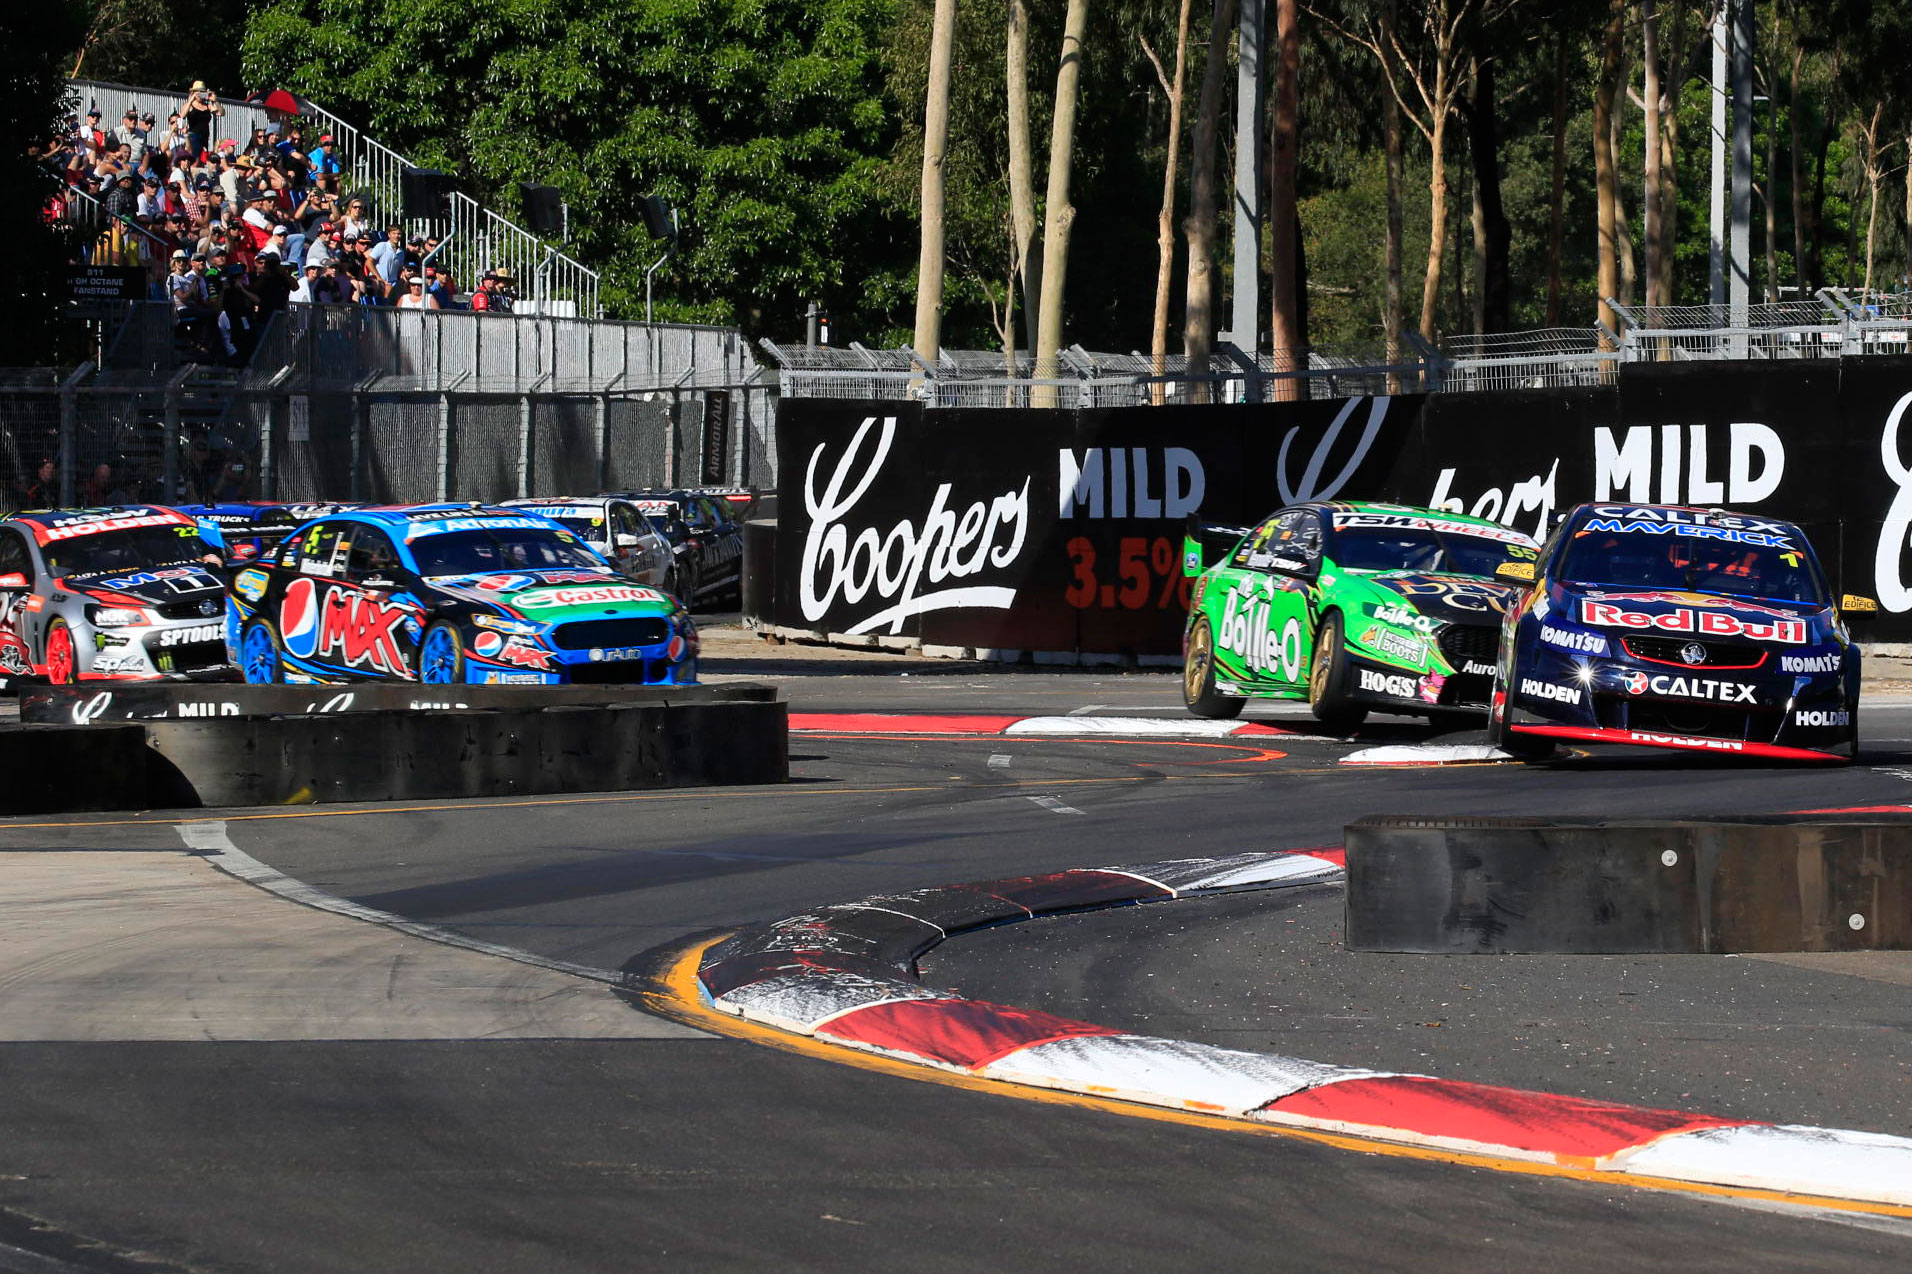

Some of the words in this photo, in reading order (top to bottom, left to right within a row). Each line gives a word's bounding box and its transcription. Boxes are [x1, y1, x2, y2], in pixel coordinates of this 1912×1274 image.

[89, 278, 125, 287] OCTANE
[1595, 421, 1786, 505] MILD
[1059, 446, 1206, 519] MILD
[48, 513, 180, 540] HOLDEN
[591, 517, 603, 527] 9
[799, 416, 1031, 635] Coopers
[1416, 518, 1530, 545] WHEELS
[1583, 518, 1797, 551] MAVERICK
[1506, 544, 1538, 561] 55
[1779, 552, 1799, 568] 1
[1498, 565, 1534, 576] EDIFICE
[555, 586, 660, 604] Castrol
[319, 585, 414, 681] MAX
[1583, 600, 1694, 632] Red
[1699, 611, 1806, 643] Bull
[1381, 639, 1419, 662] BOOTS
[1540, 623, 1606, 654] KOMATSU
[1521, 678, 1581, 705] HOLDEN
[1650, 675, 1758, 705] CALTEX
[1795, 710, 1849, 727] HOLDEN
